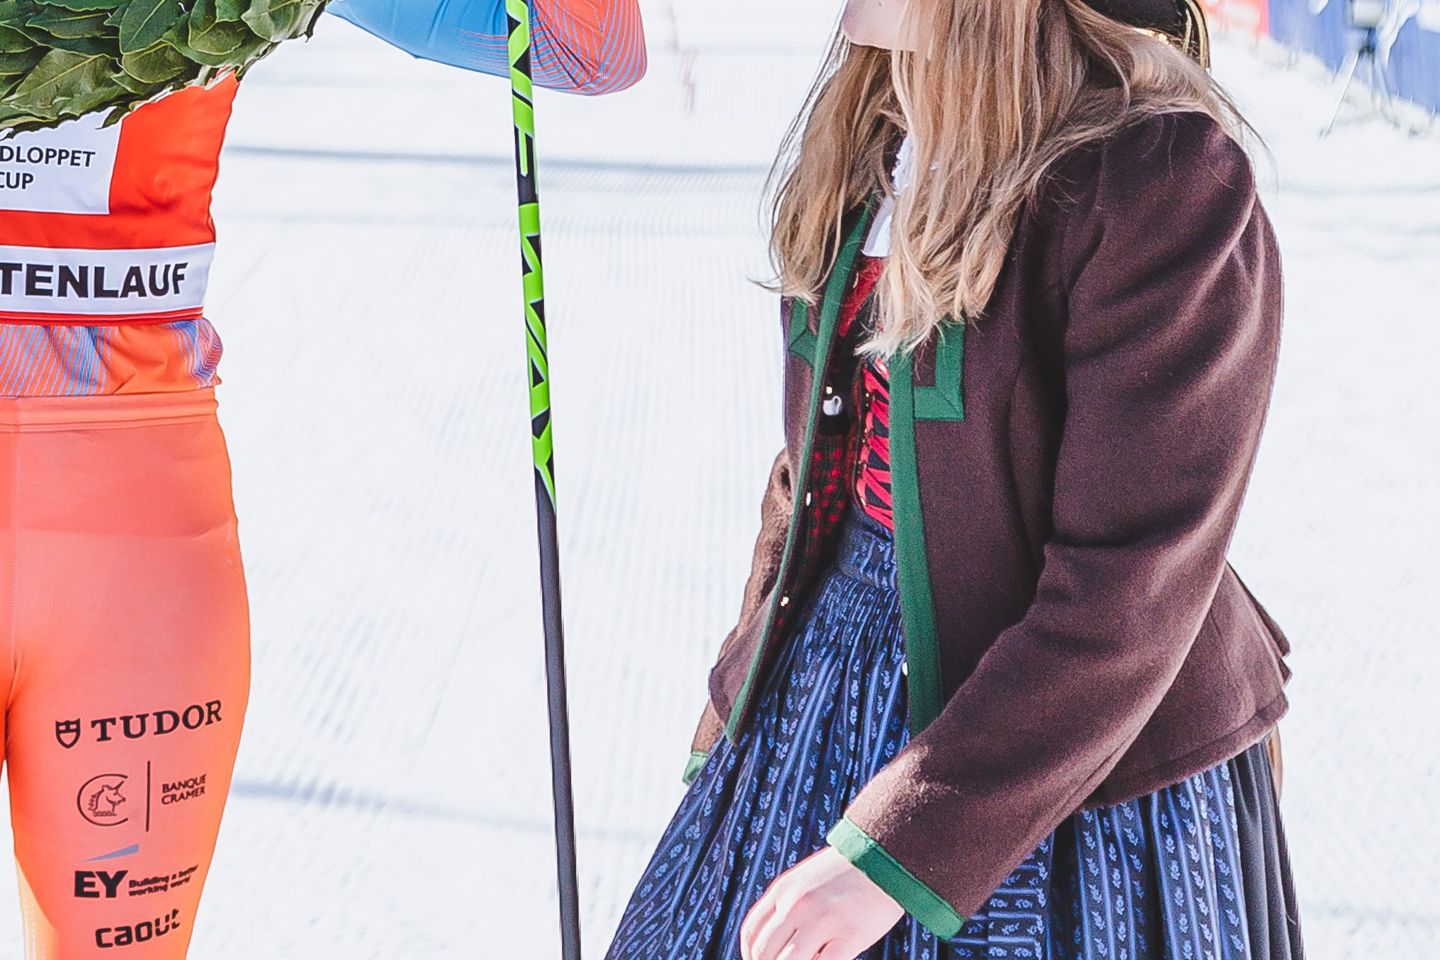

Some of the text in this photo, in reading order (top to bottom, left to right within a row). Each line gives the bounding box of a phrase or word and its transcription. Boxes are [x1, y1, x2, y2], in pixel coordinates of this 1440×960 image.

[90, 699, 222, 743] TUDOR
[160, 786, 206, 806] CRAMER
[161, 773, 207, 795] BANQUE
[73, 869, 129, 899] EY
